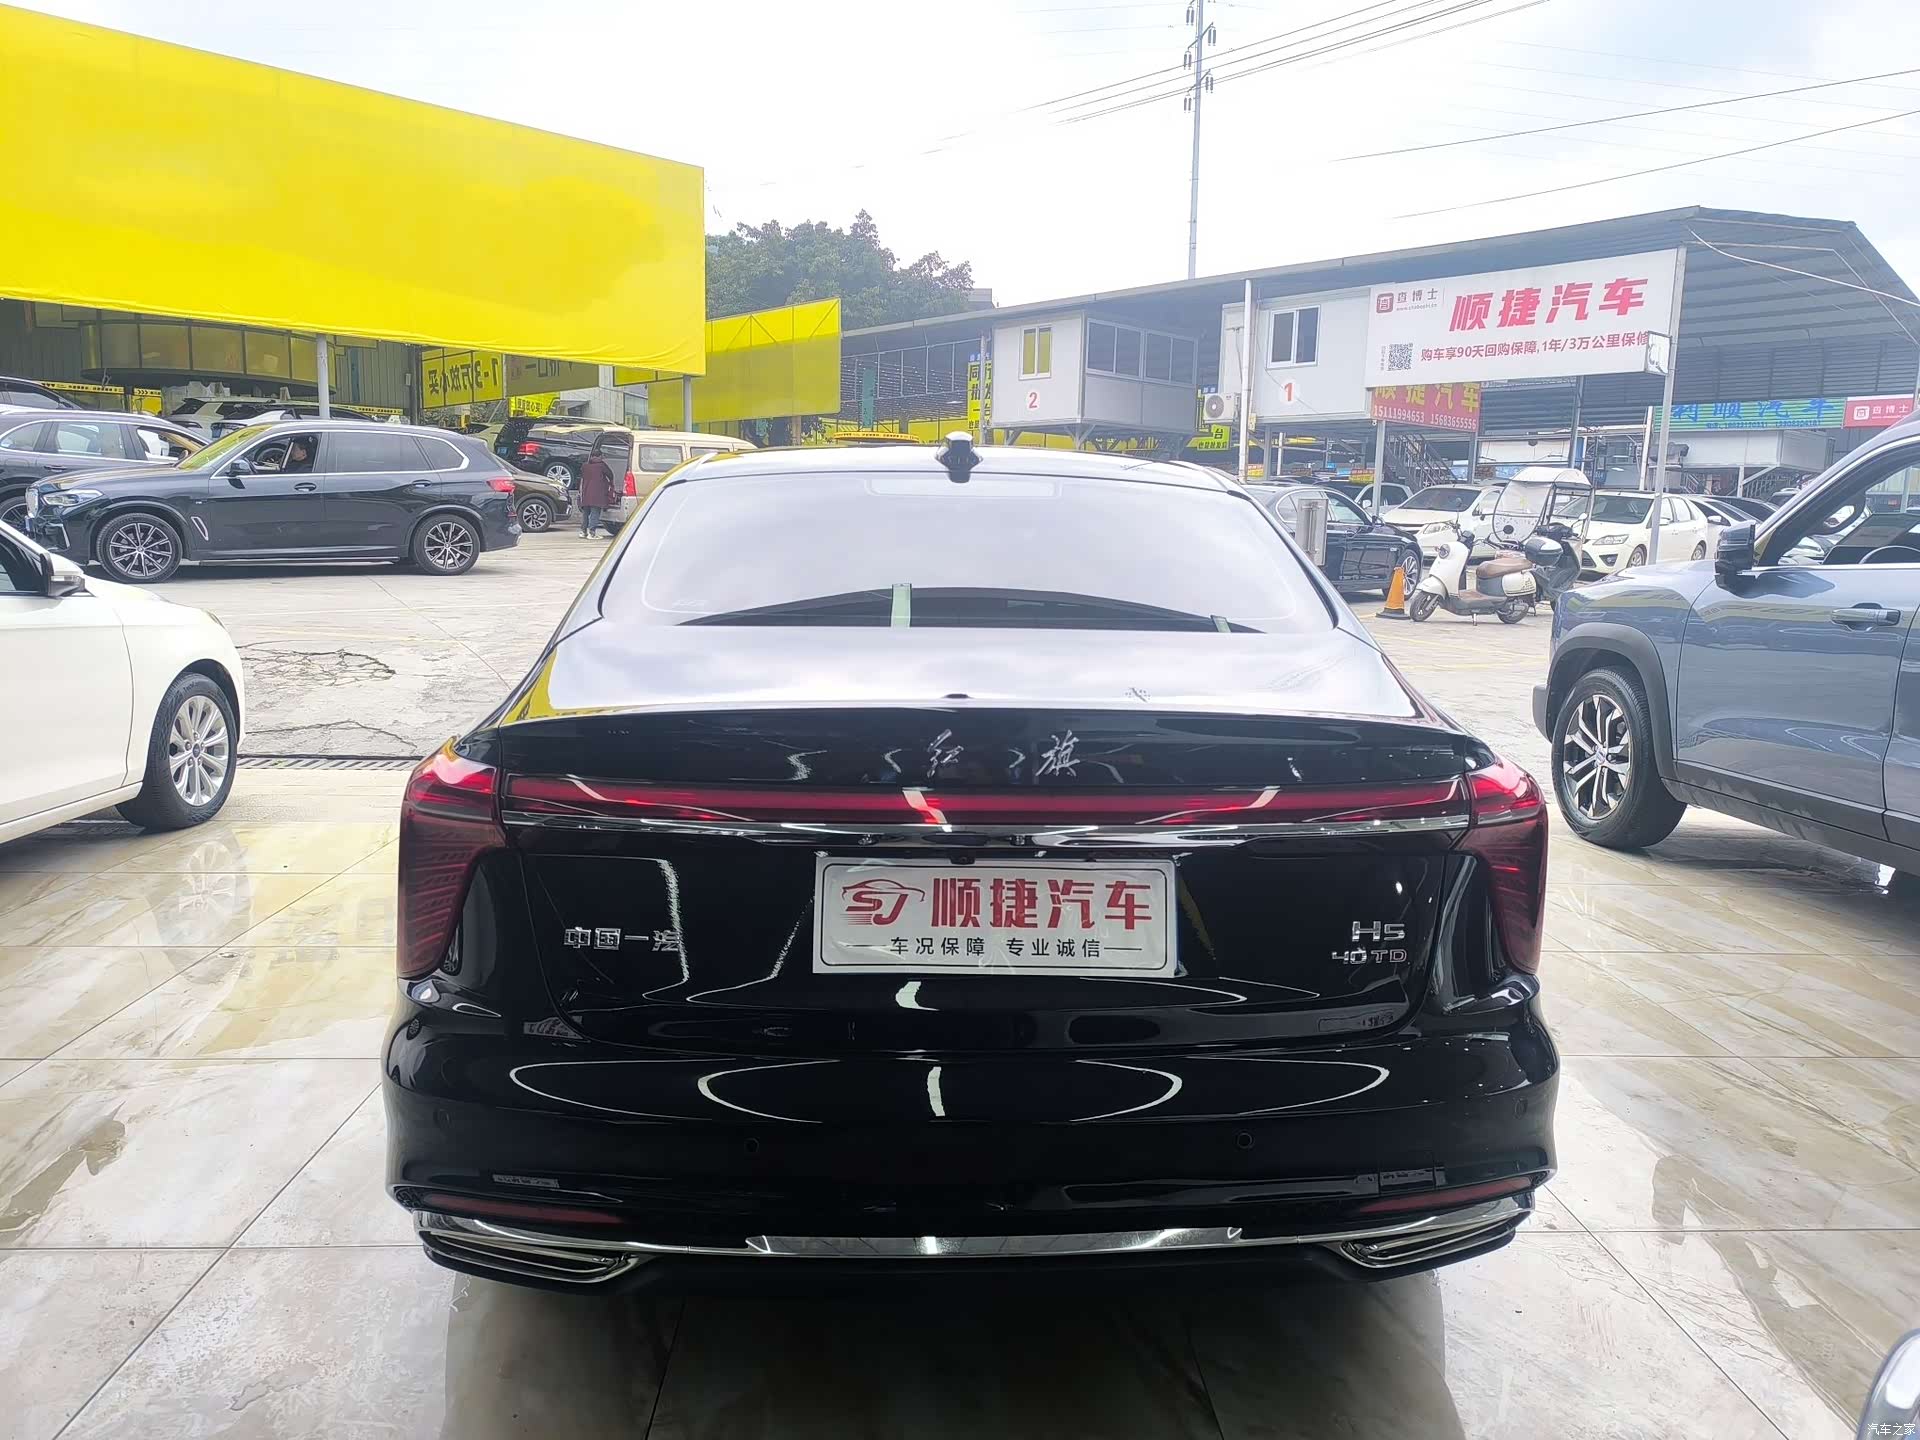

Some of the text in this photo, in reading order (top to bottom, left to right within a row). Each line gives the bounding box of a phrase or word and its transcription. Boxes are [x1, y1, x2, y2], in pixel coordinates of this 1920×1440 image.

[1449, 277, 1648, 332] 顺捷汽车
[1029, 391, 1038, 409] 2
[1284, 382, 1293, 402] 1
[931, 877, 1153, 930] 顺捷汽车
[890, 936, 1101, 957] 车况保障 专业诚信
